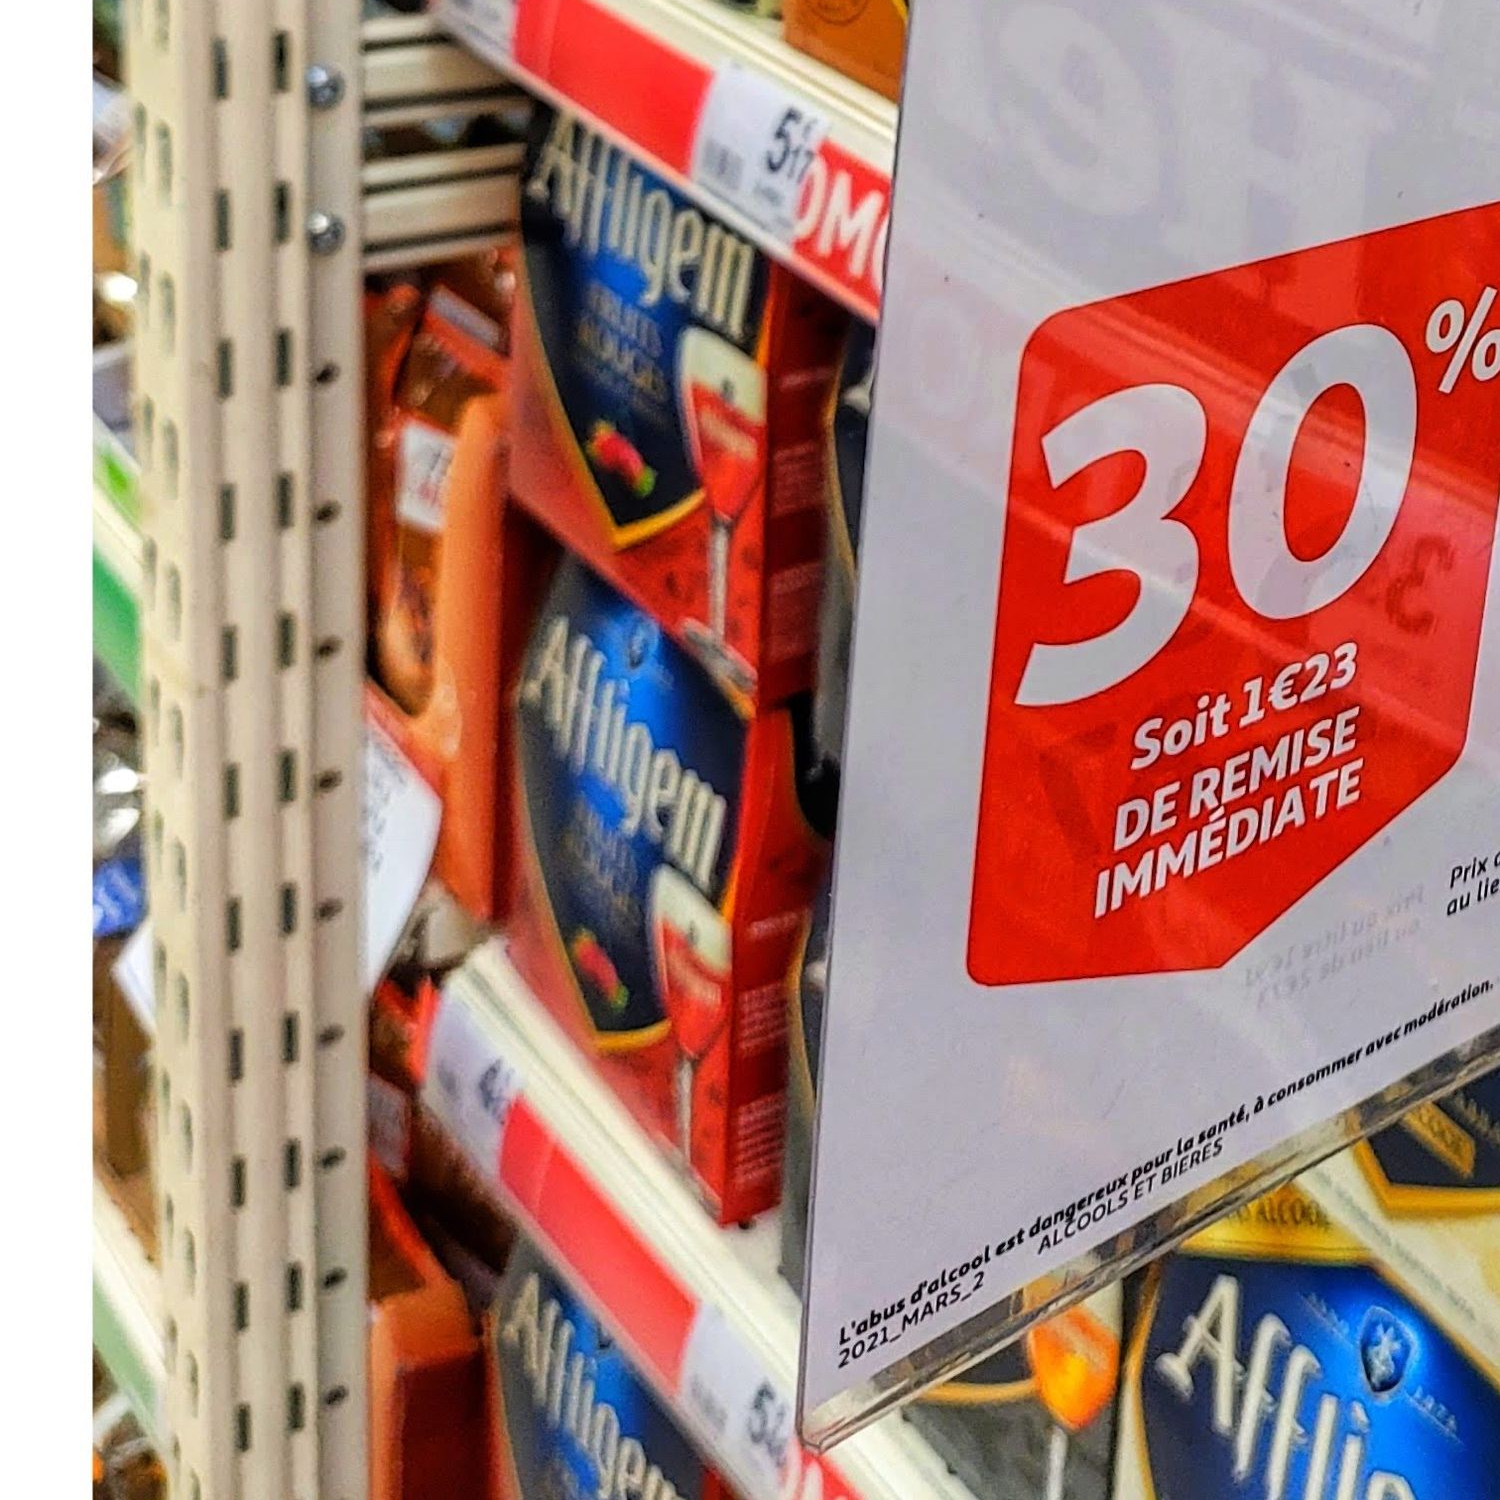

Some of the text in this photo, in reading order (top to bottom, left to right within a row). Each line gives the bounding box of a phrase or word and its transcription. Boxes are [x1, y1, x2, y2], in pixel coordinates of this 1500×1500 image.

[1112, 704, 1362, 853] DE REMISE
[1129, 638, 1358, 771] Soit 1€23
[1092, 755, 1365, 920] IMMÉDIATE
[1446, 891, 1471, 917] au
[1450, 856, 1489, 889] Prix
[838, 979, 1495, 1346] L'abus d'alcool est dangereux pour la santé, à consommer avec modération.
[838, 1137, 1224, 1369] 2021_MARS_2 ALCOOLS ET BIERES
[1154, 1272, 1418, 1500] Affli
